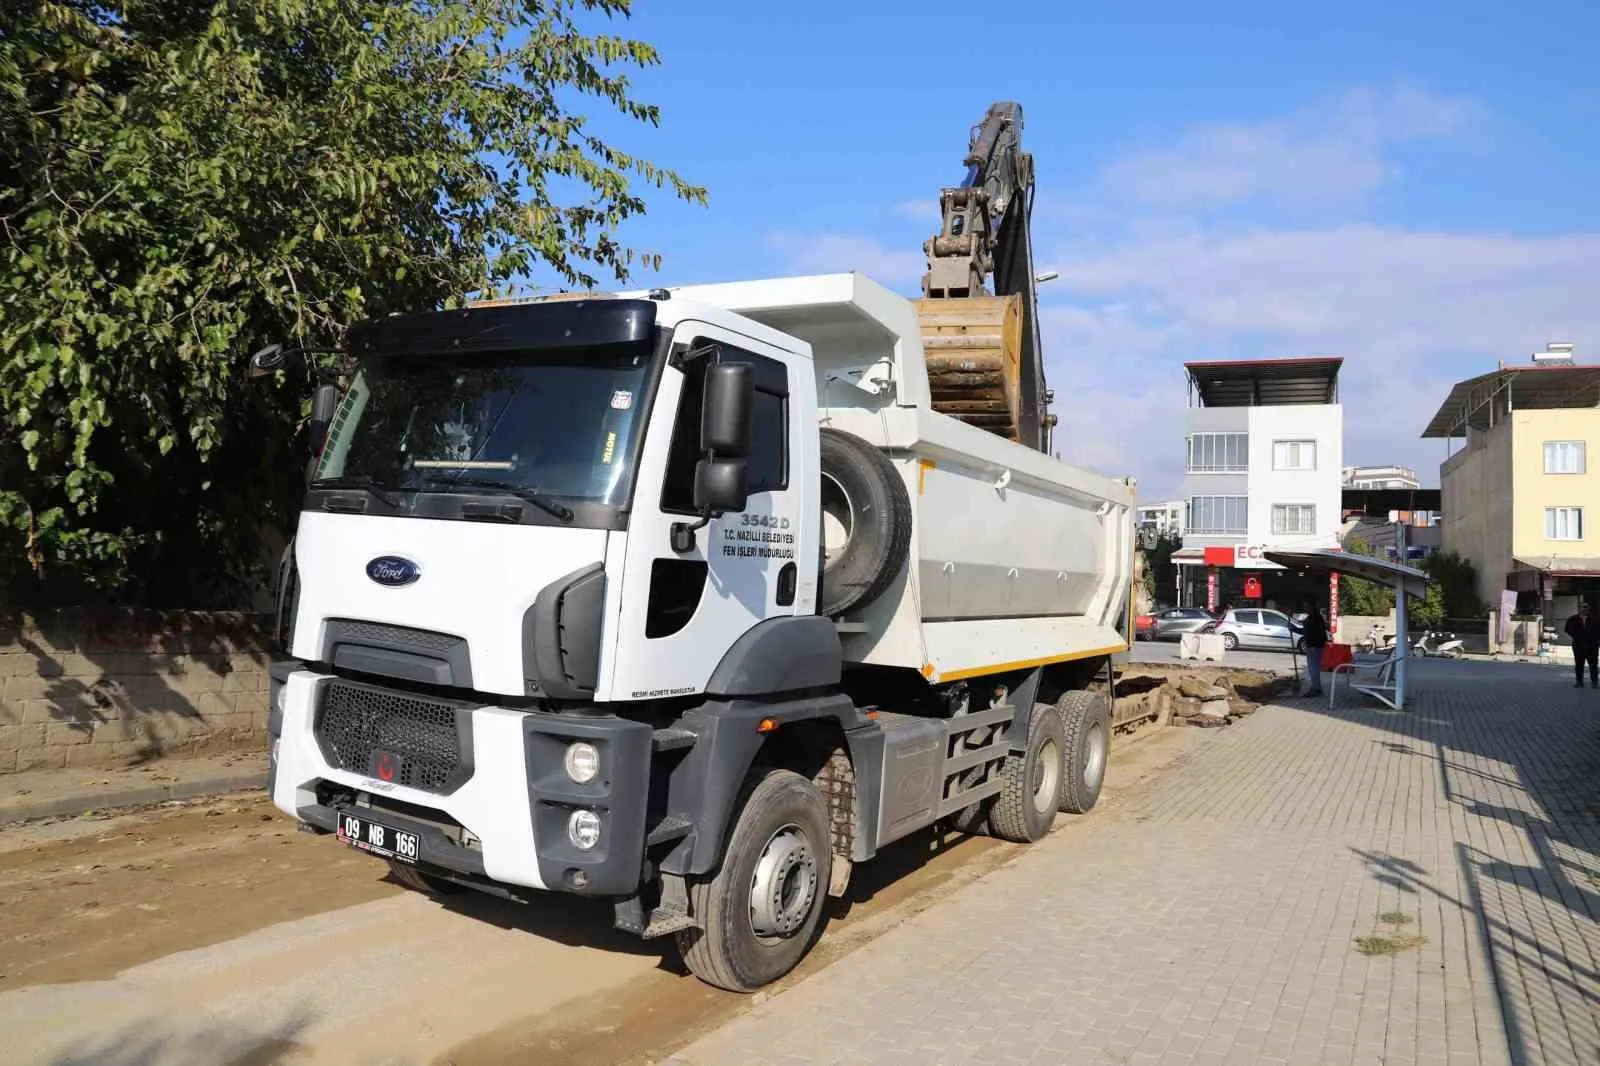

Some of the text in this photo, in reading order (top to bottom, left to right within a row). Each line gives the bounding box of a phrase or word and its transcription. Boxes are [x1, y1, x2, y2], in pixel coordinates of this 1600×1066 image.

[741, 514, 790, 529] 3542 D
[724, 529, 735, 540] T.C.
[723, 545, 736, 556] FEN
[373, 561, 405, 580] Ford
[345, 817, 360, 839] 09
[368, 824, 385, 846] NB
[395, 832, 416, 857] 166
